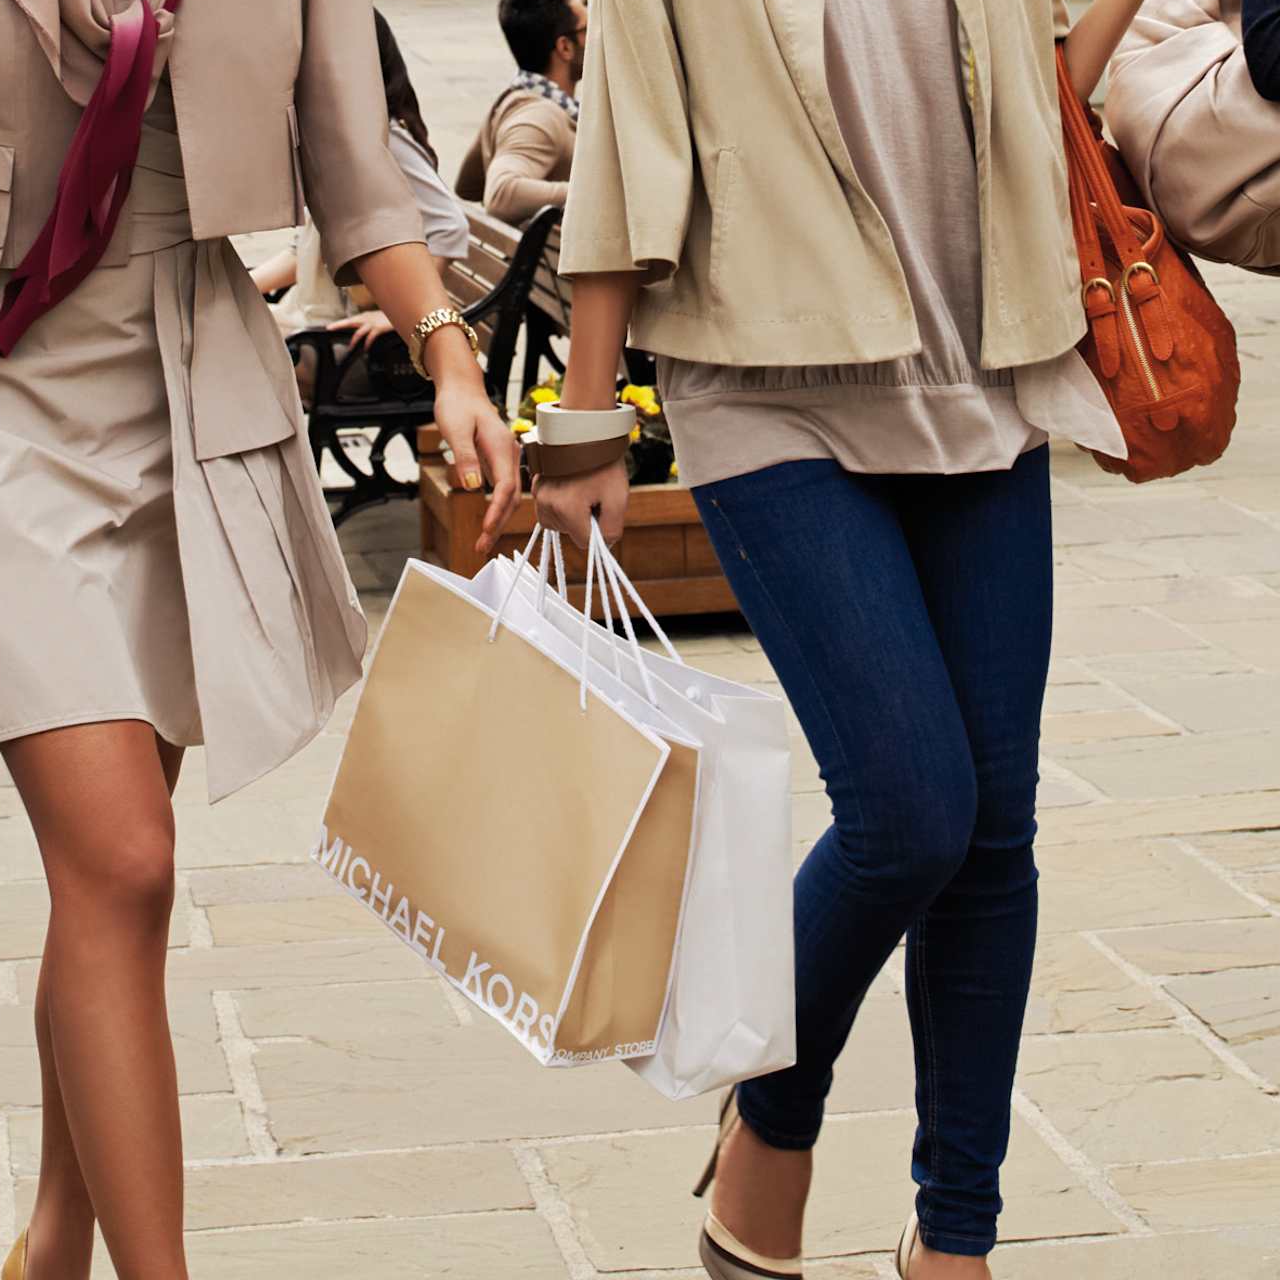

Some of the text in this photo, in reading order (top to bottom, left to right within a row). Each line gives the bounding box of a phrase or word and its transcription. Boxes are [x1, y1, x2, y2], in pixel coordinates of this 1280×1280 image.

[316, 823, 558, 1057] MICHAEL KORS
[614, 1039, 656, 1056] STORE
